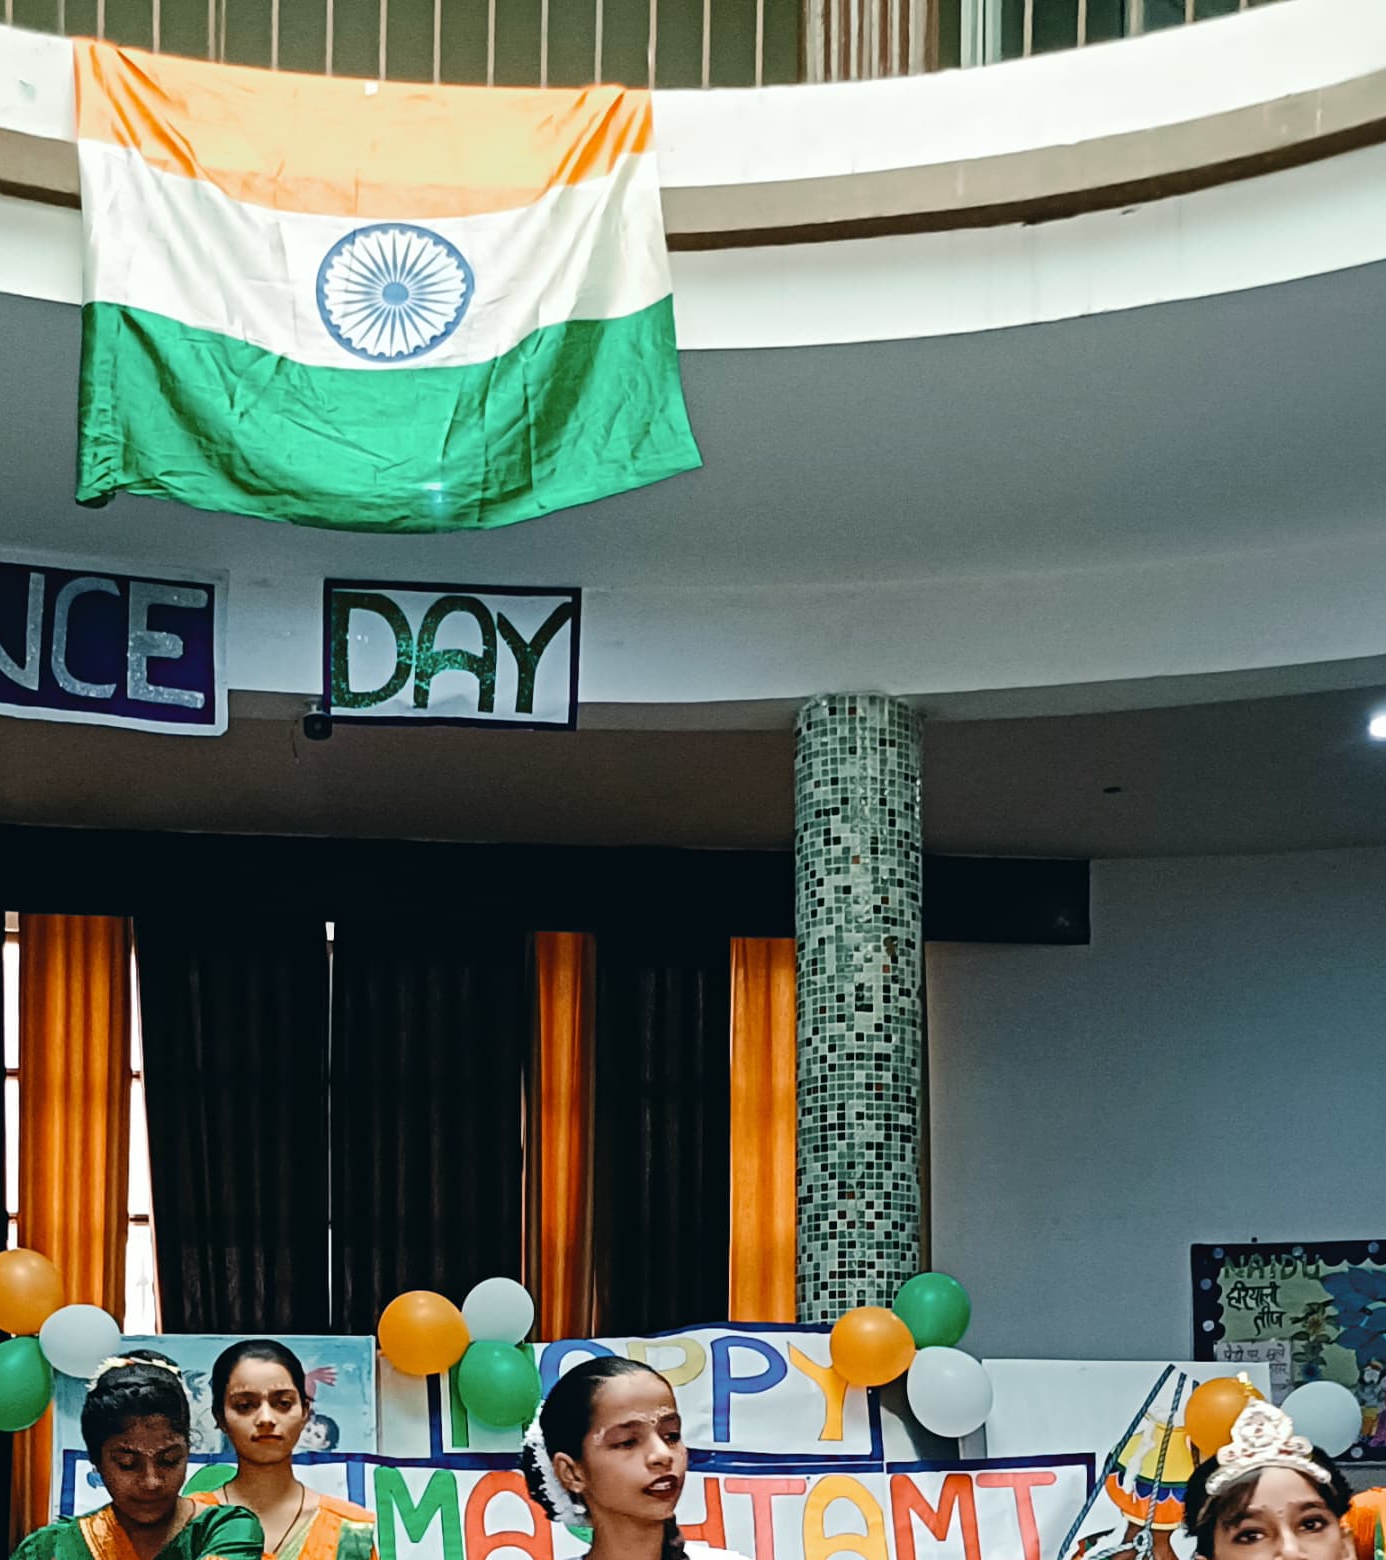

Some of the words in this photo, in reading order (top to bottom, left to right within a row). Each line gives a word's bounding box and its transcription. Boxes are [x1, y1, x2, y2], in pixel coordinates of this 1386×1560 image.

[331, 591, 574, 714] DAY
[1253, 1305, 1287, 1337] तीज
[449, 1334, 849, 1448] PPY
